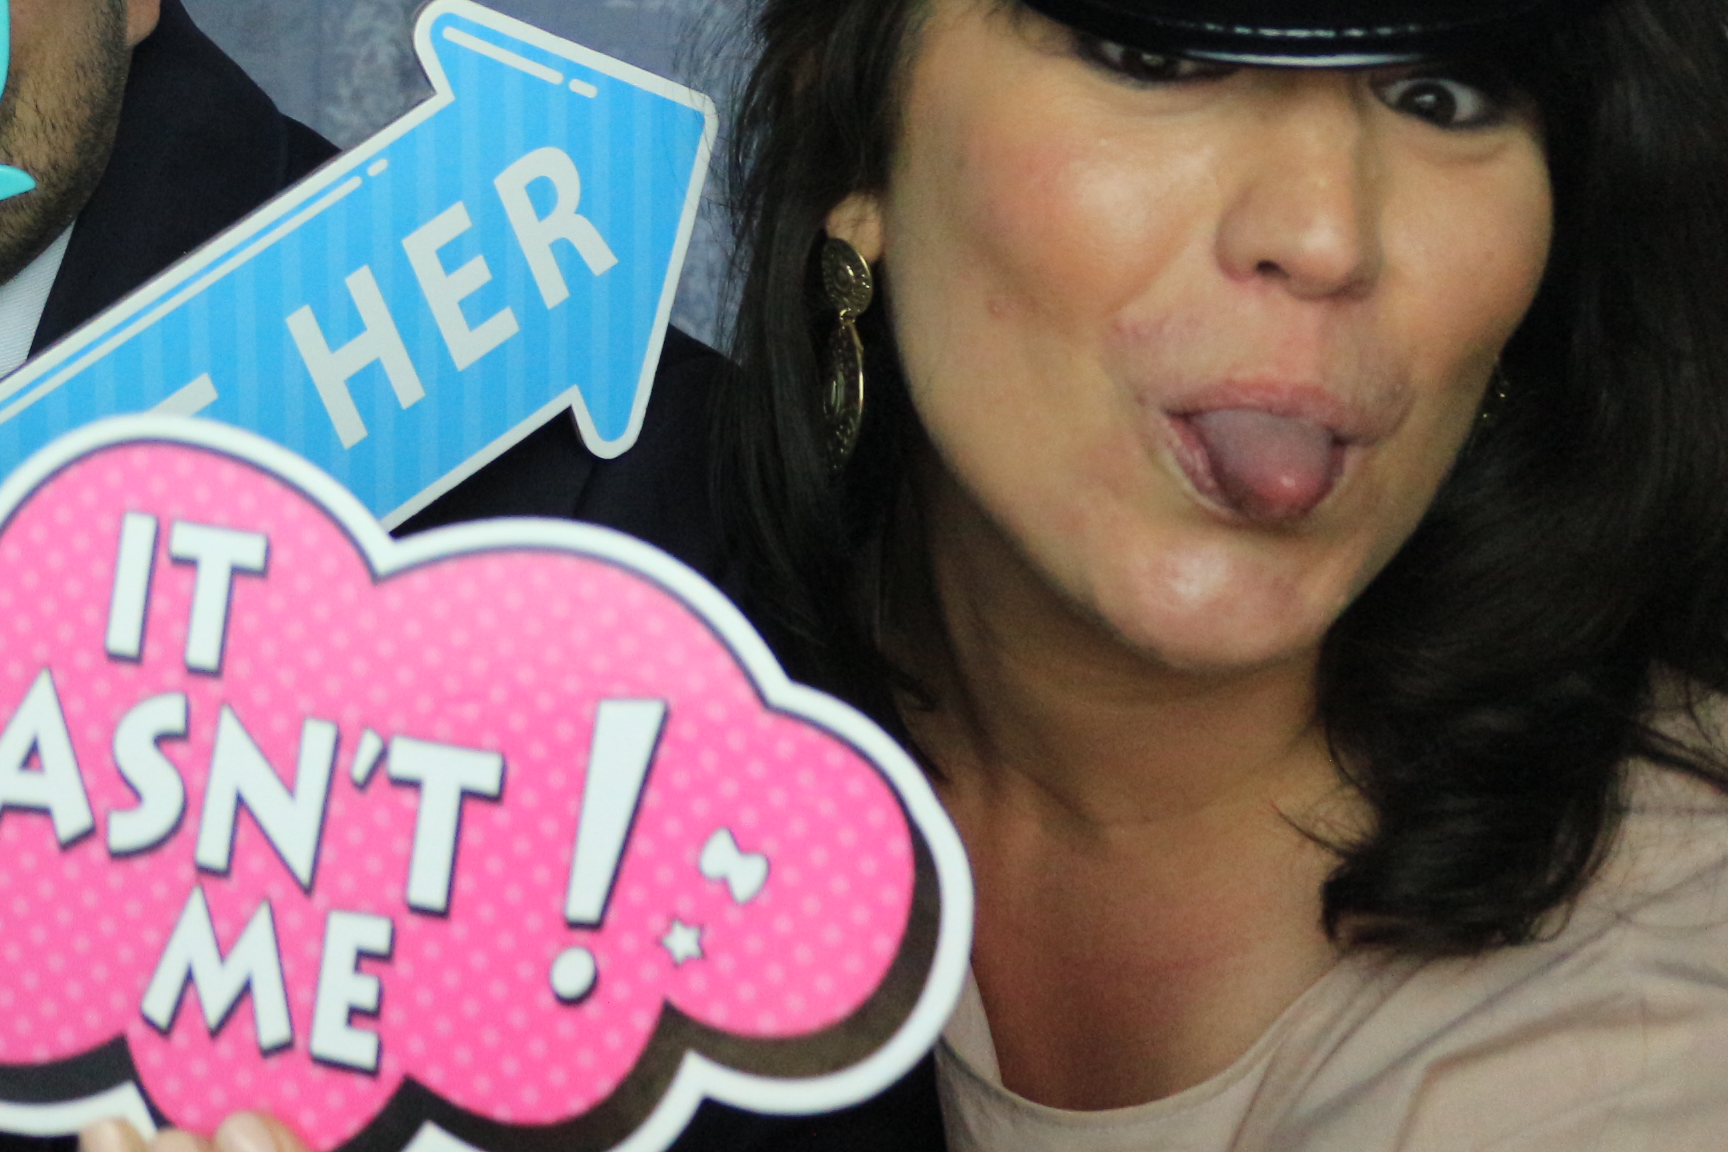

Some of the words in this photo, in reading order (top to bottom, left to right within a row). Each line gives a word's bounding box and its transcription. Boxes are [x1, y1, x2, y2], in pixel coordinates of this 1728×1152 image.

[285, 145, 619, 450] HER
[105, 513, 269, 674] IT
[141, 884, 394, 1075] ME
